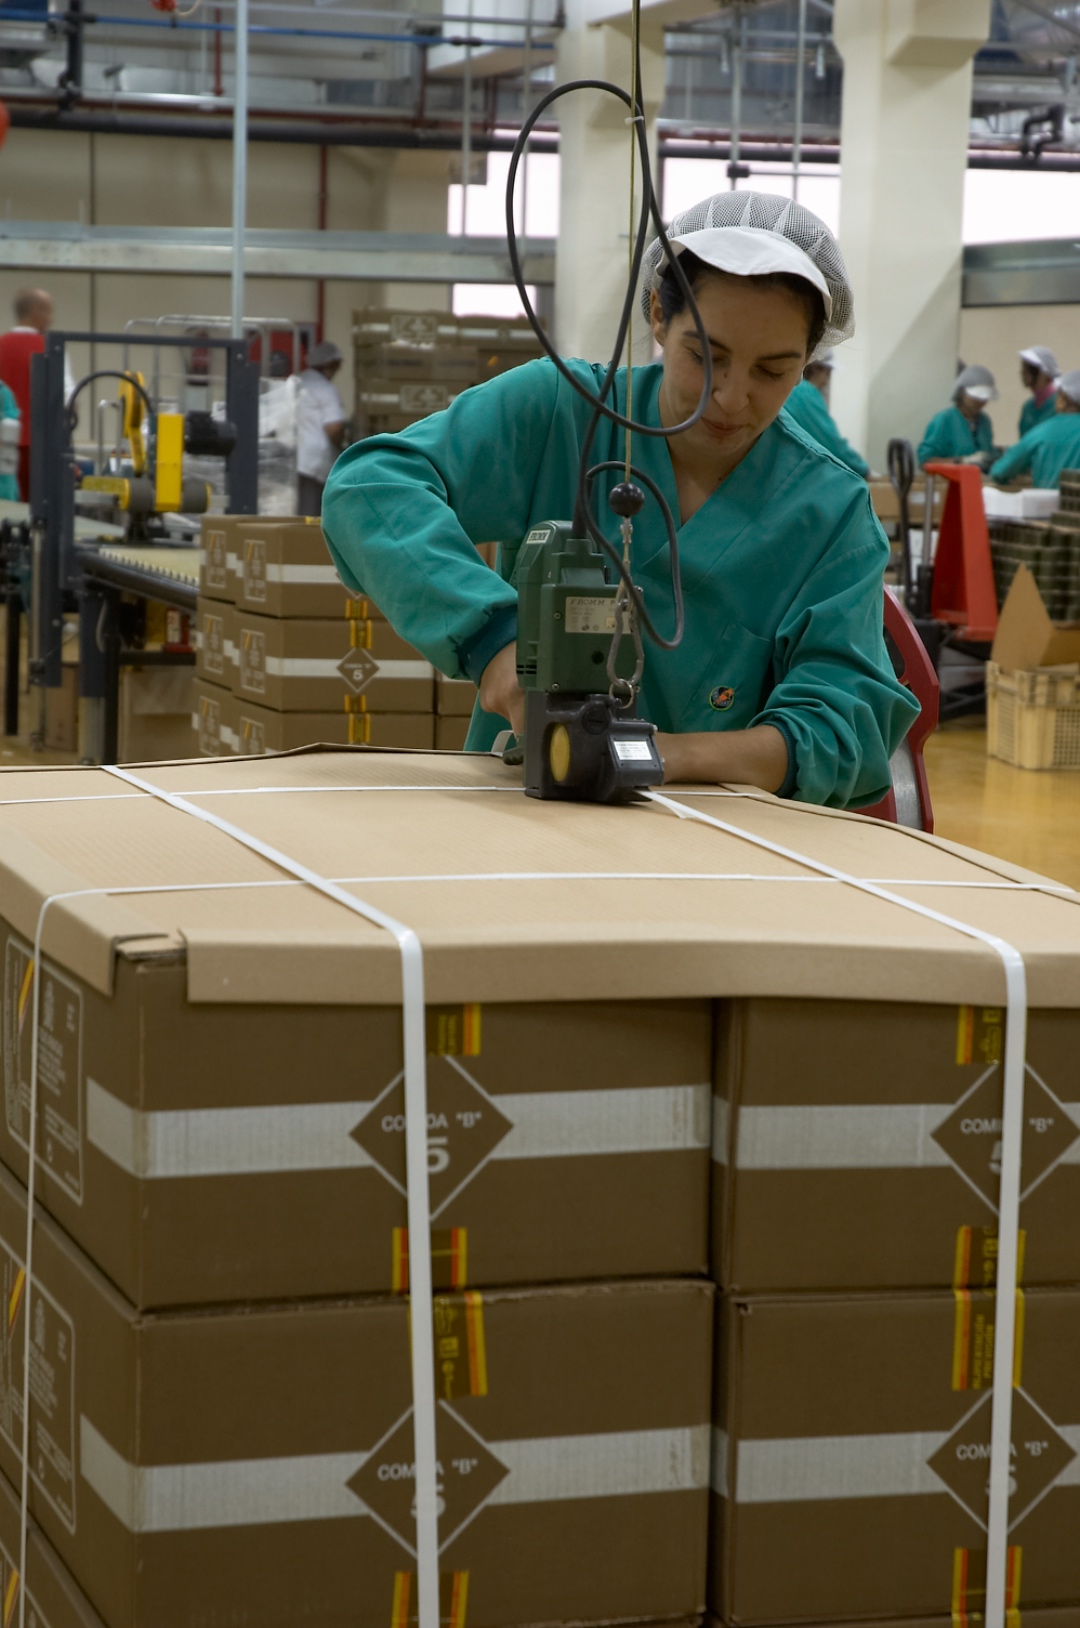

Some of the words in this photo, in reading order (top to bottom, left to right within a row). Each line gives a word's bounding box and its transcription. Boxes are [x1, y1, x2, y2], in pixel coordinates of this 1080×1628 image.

[352, 669, 364, 681] 5
[381, 1113, 448, 1132] CODA
[956, 1443, 1017, 1460] COMA
[377, 1461, 444, 1481] COMA
